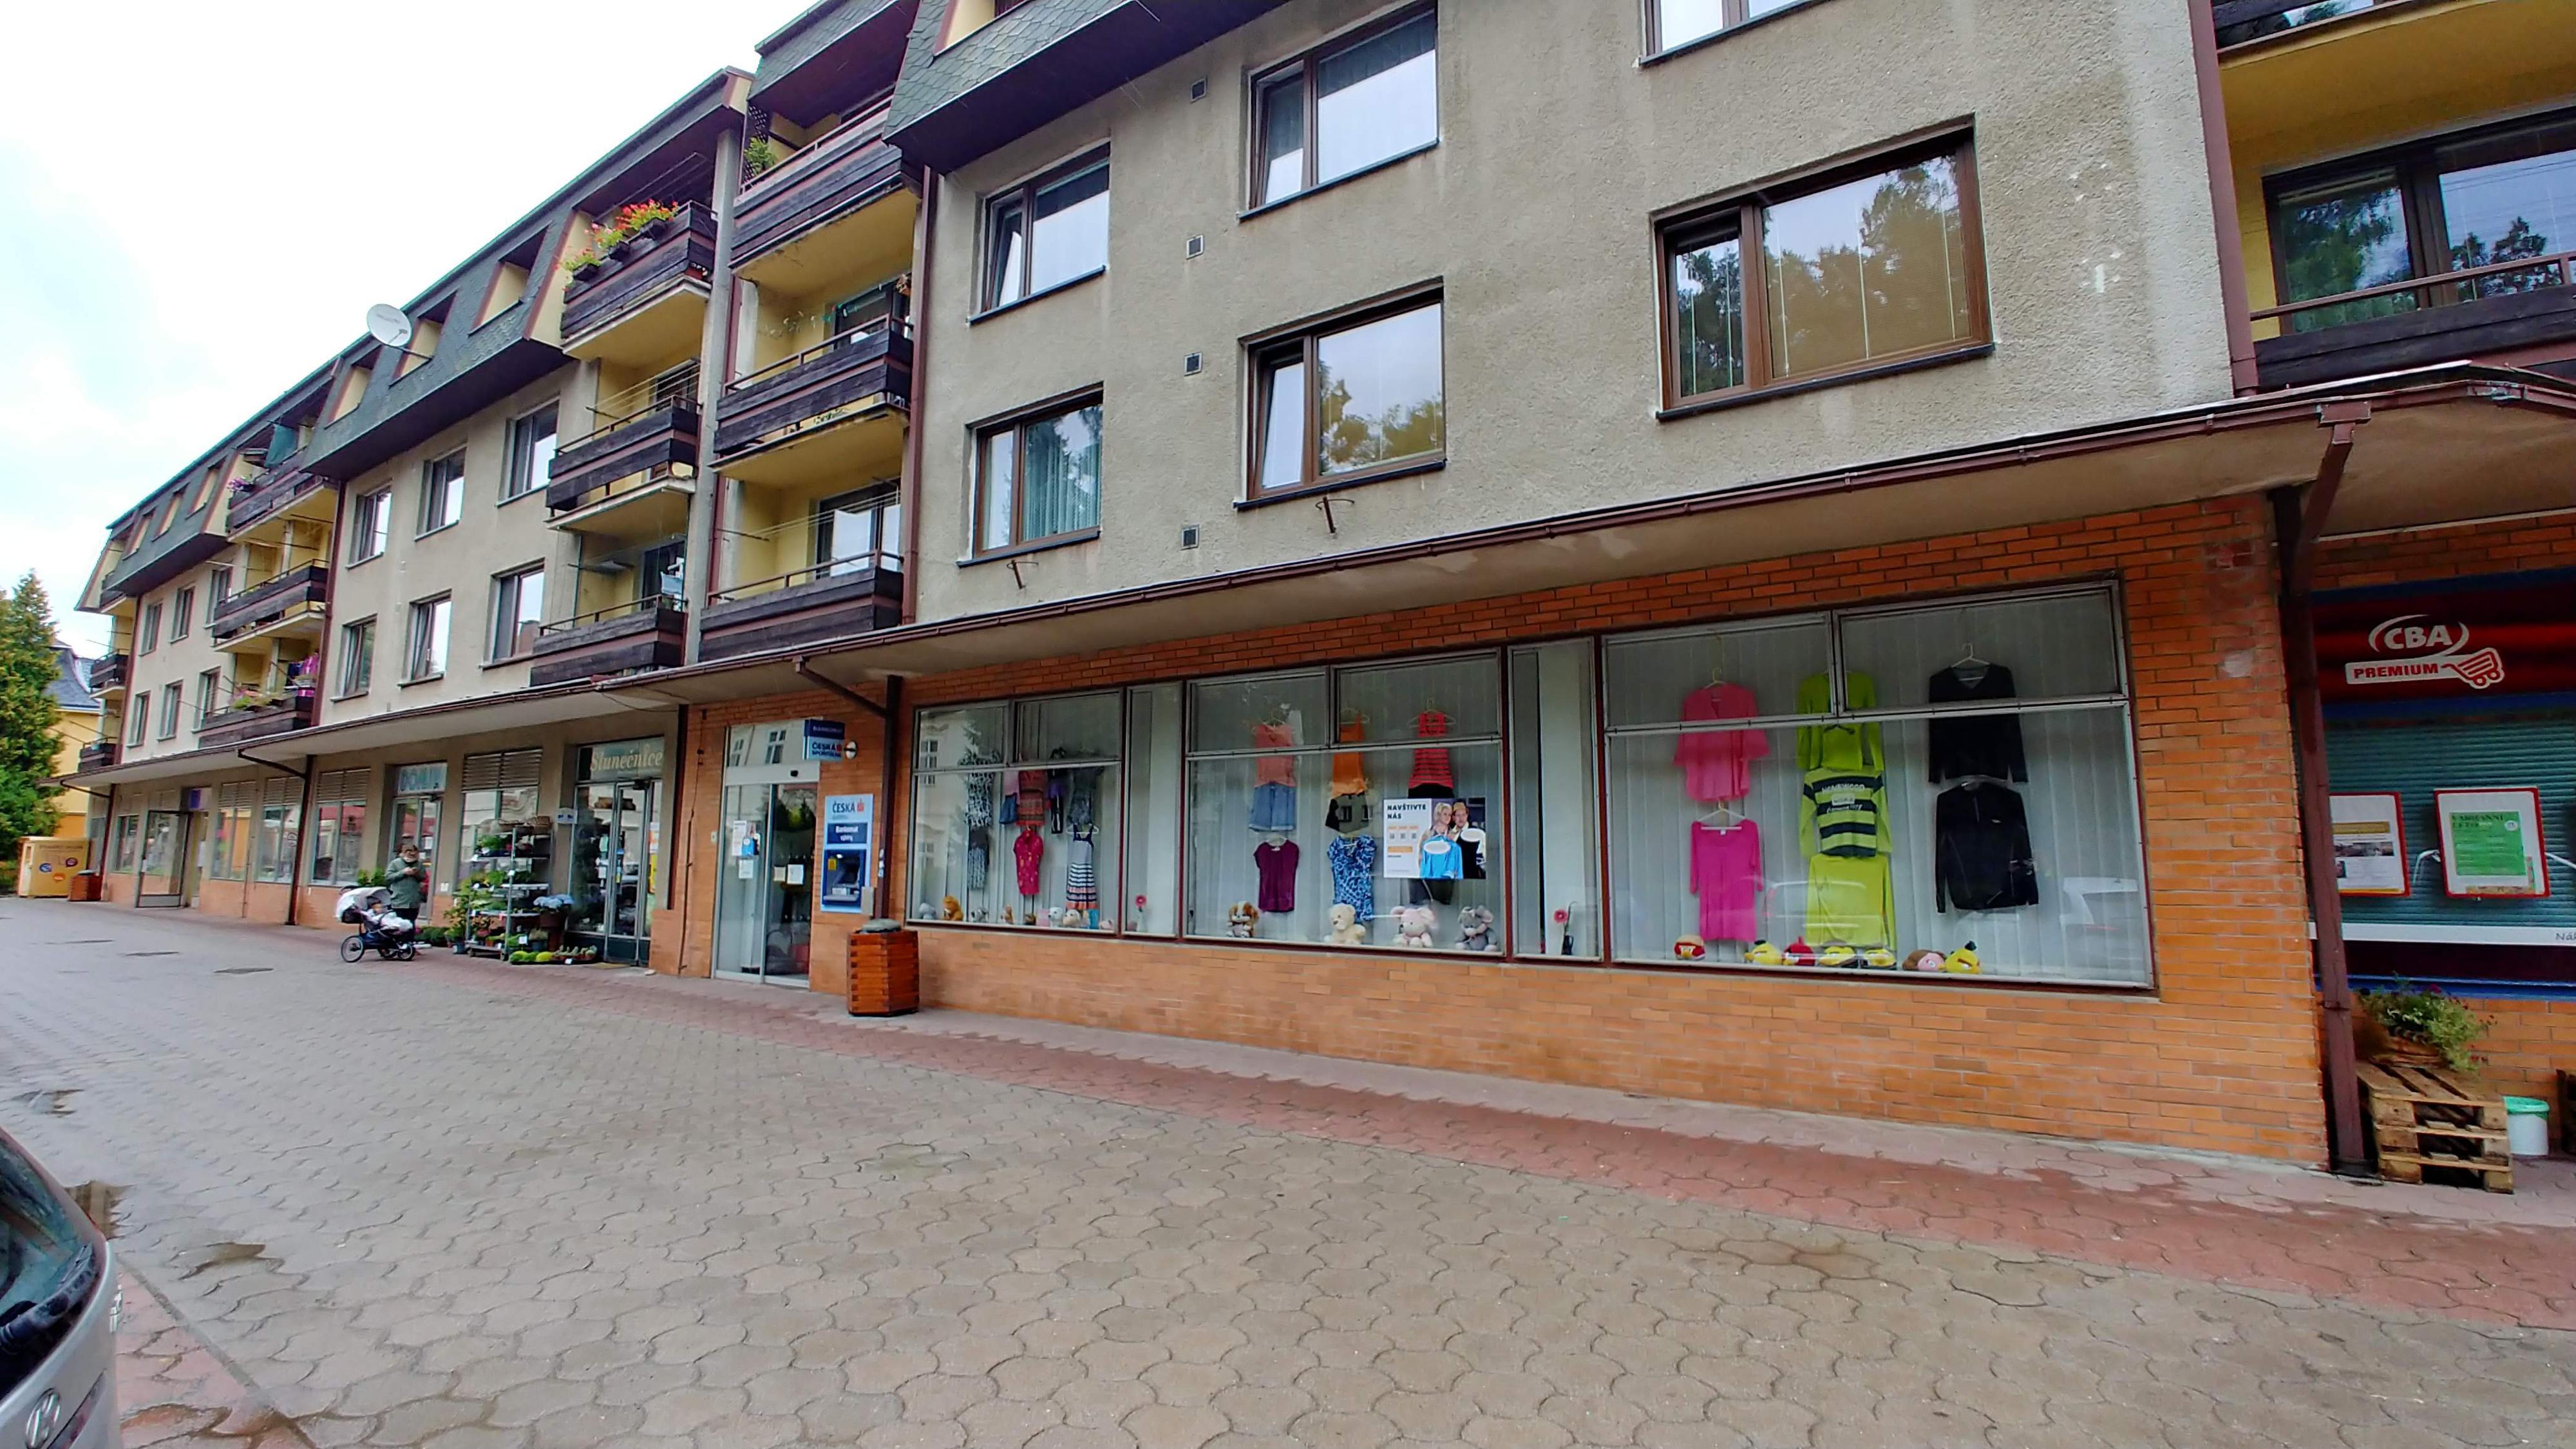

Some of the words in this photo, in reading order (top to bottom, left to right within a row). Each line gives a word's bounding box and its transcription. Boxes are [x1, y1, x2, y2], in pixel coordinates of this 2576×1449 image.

[2384, 625, 2452, 649] CBA
[2353, 663, 2439, 679] PREMIUM
[833, 800, 855, 813] ČESKÁ
